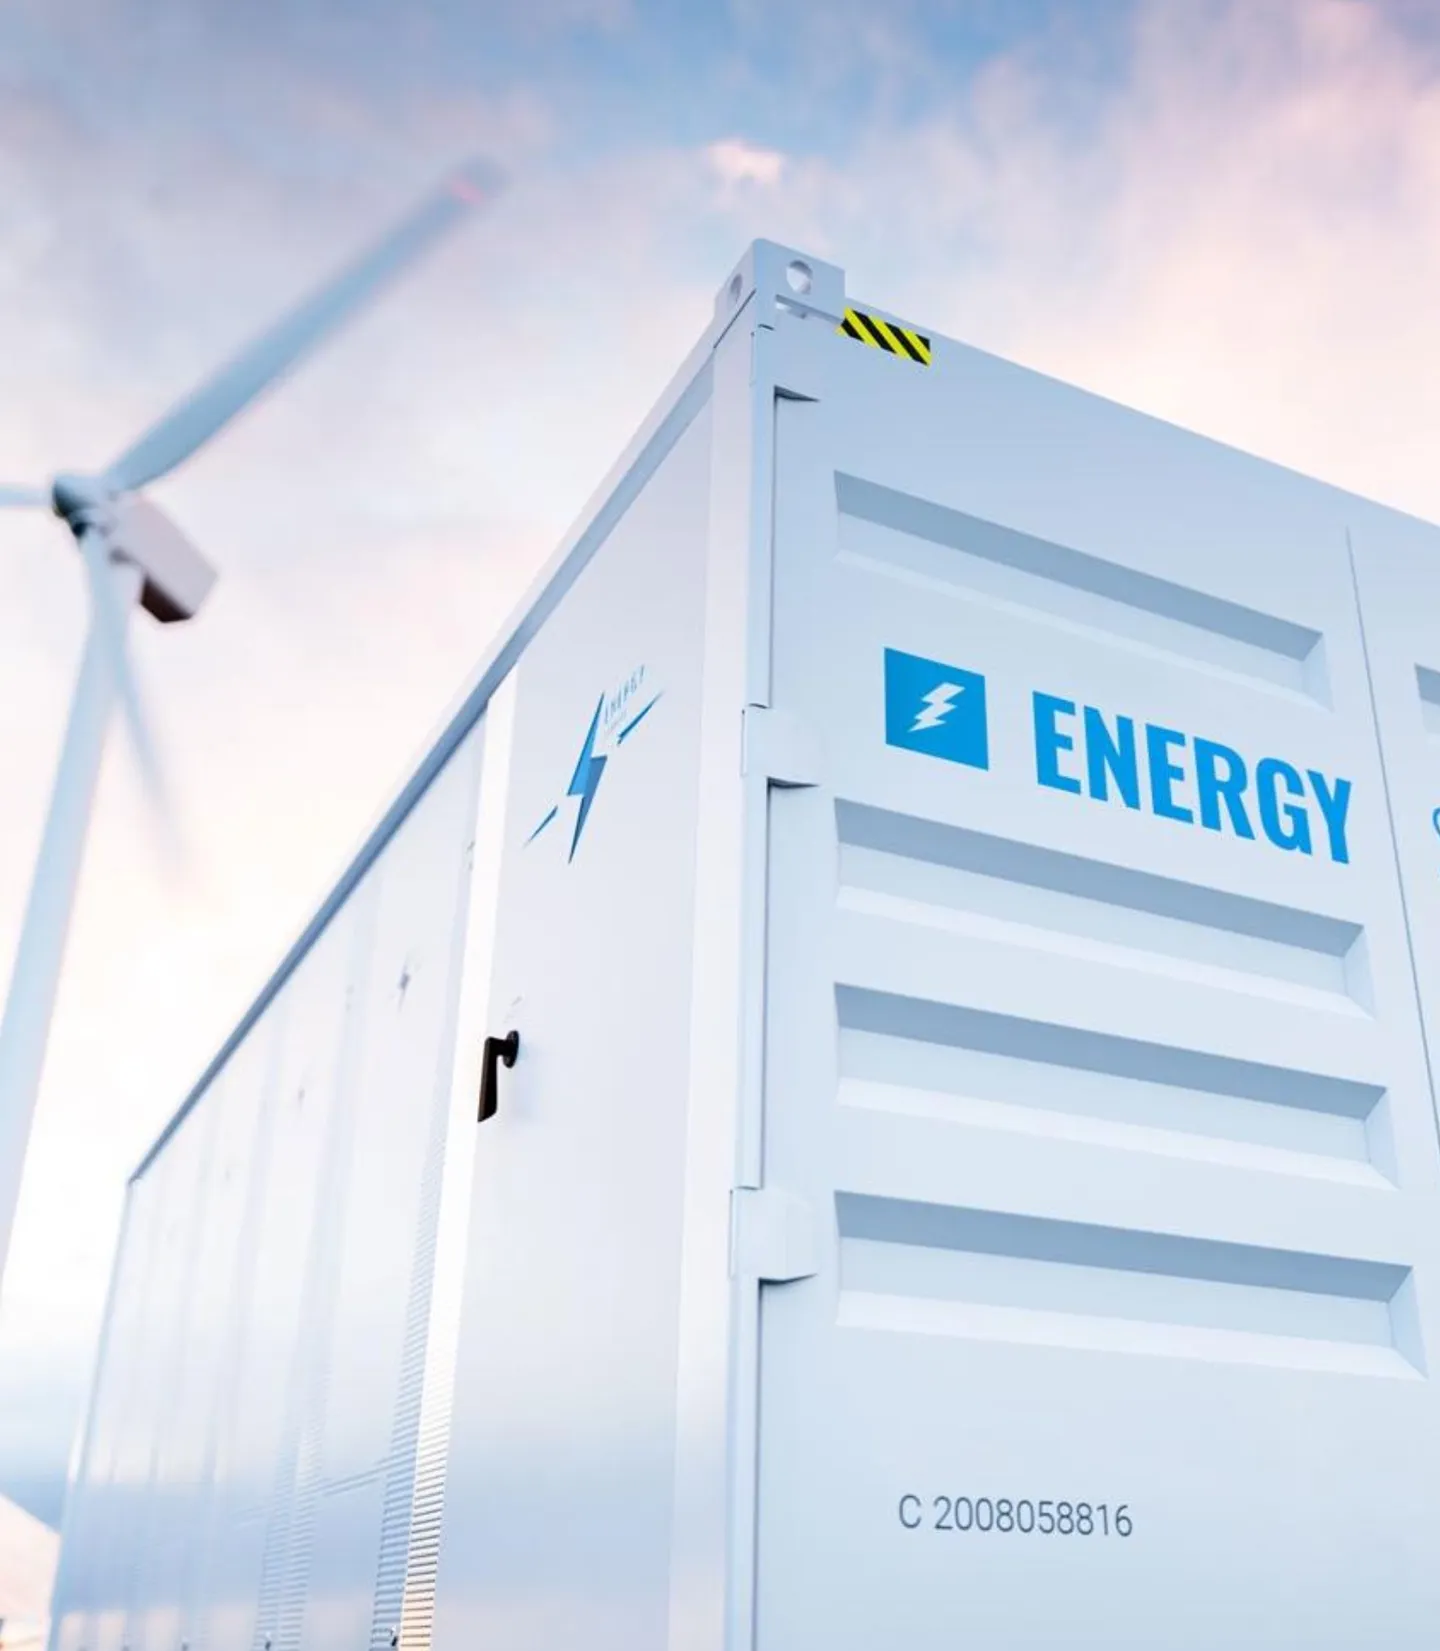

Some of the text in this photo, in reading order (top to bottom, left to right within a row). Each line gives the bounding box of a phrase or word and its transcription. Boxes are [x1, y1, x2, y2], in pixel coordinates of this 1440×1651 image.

[1032, 691, 1351, 864] ENERGY
[899, 1494, 1133, 1537] C 2008058816
